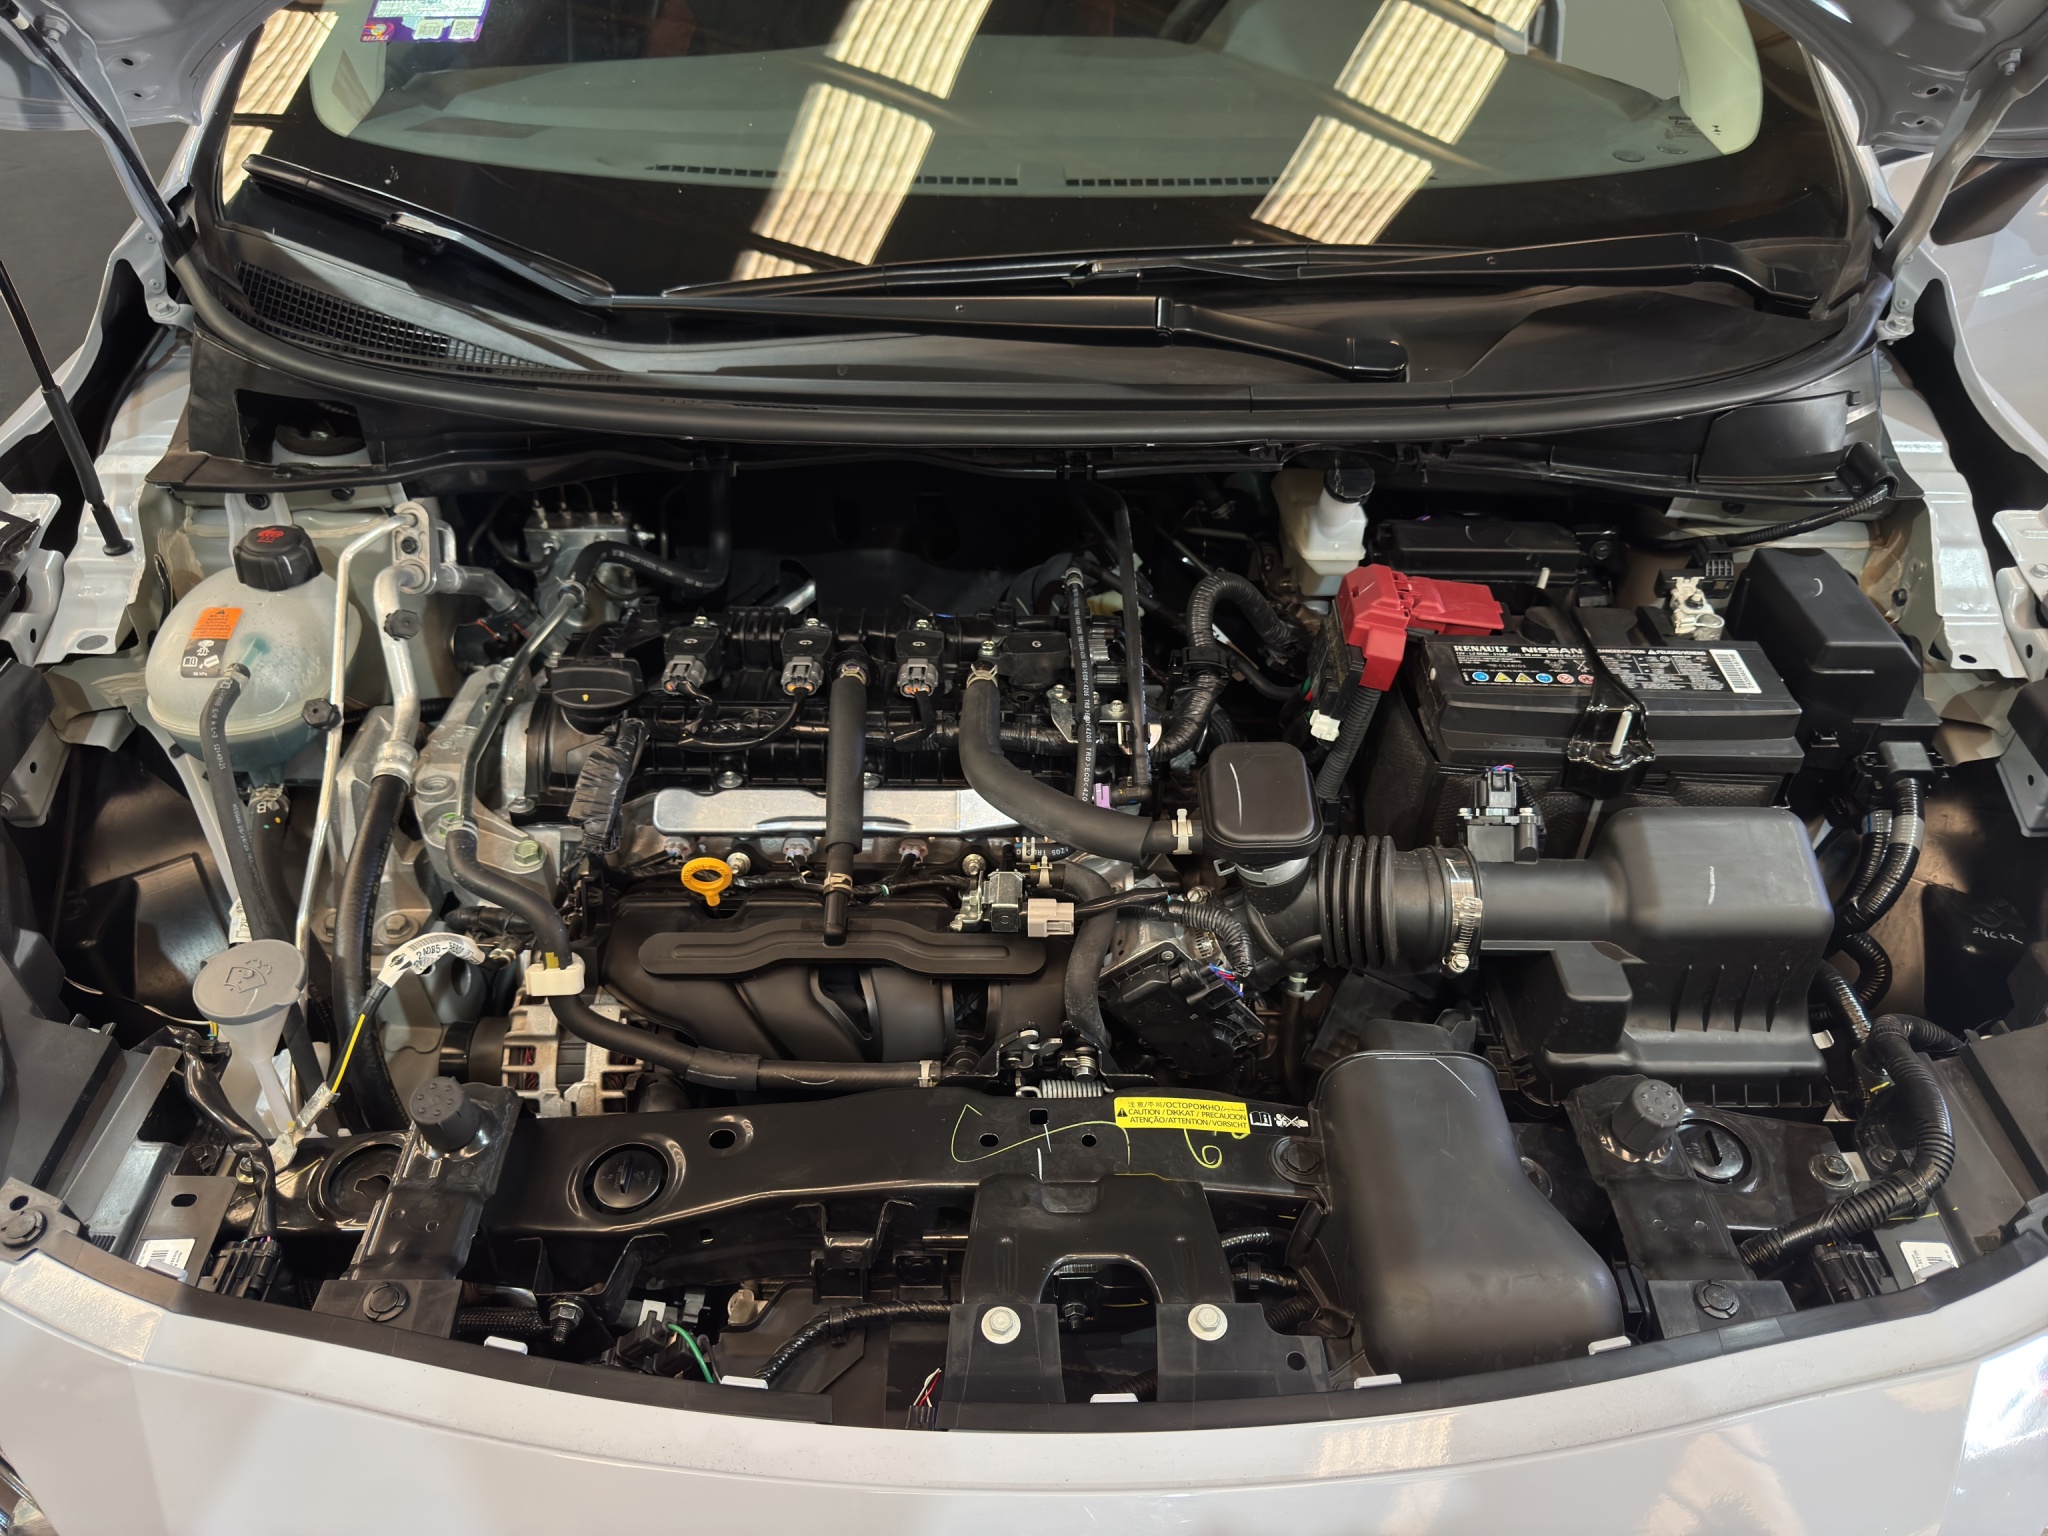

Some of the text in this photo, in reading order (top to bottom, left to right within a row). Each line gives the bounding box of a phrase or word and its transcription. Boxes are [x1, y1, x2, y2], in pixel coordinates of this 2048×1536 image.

[1453, 645, 1583, 654] RENAULT NISSAN
[1128, 1108, 1160, 1116] CAUTION
[1166, 1109, 1195, 1117] DIKKAT
